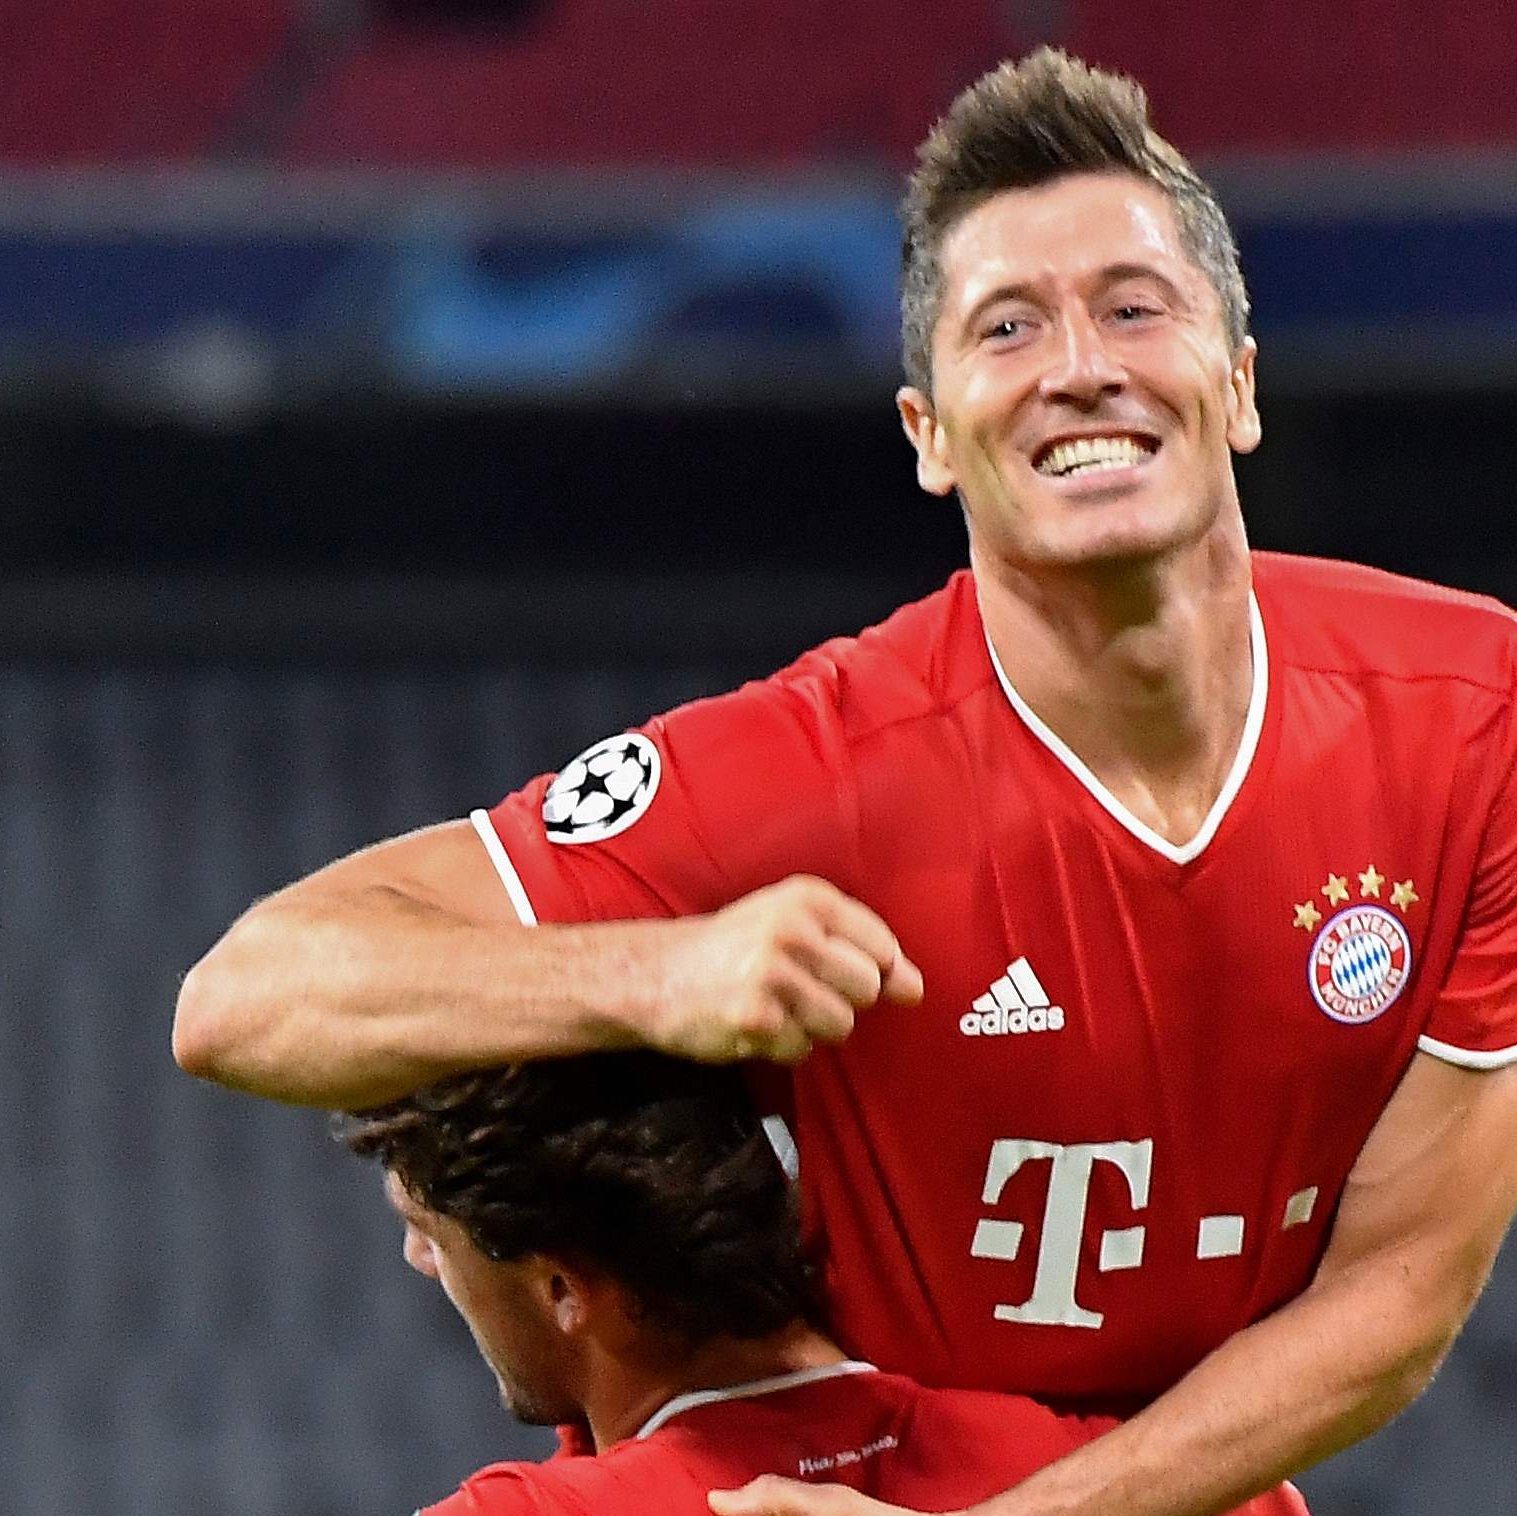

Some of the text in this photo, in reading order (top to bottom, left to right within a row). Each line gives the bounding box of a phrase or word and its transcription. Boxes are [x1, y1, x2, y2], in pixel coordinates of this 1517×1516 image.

[1336, 913, 1403, 952] BAYERN
[959, 1006, 1065, 1036] adidas
[971, 1138, 1154, 1329] T
